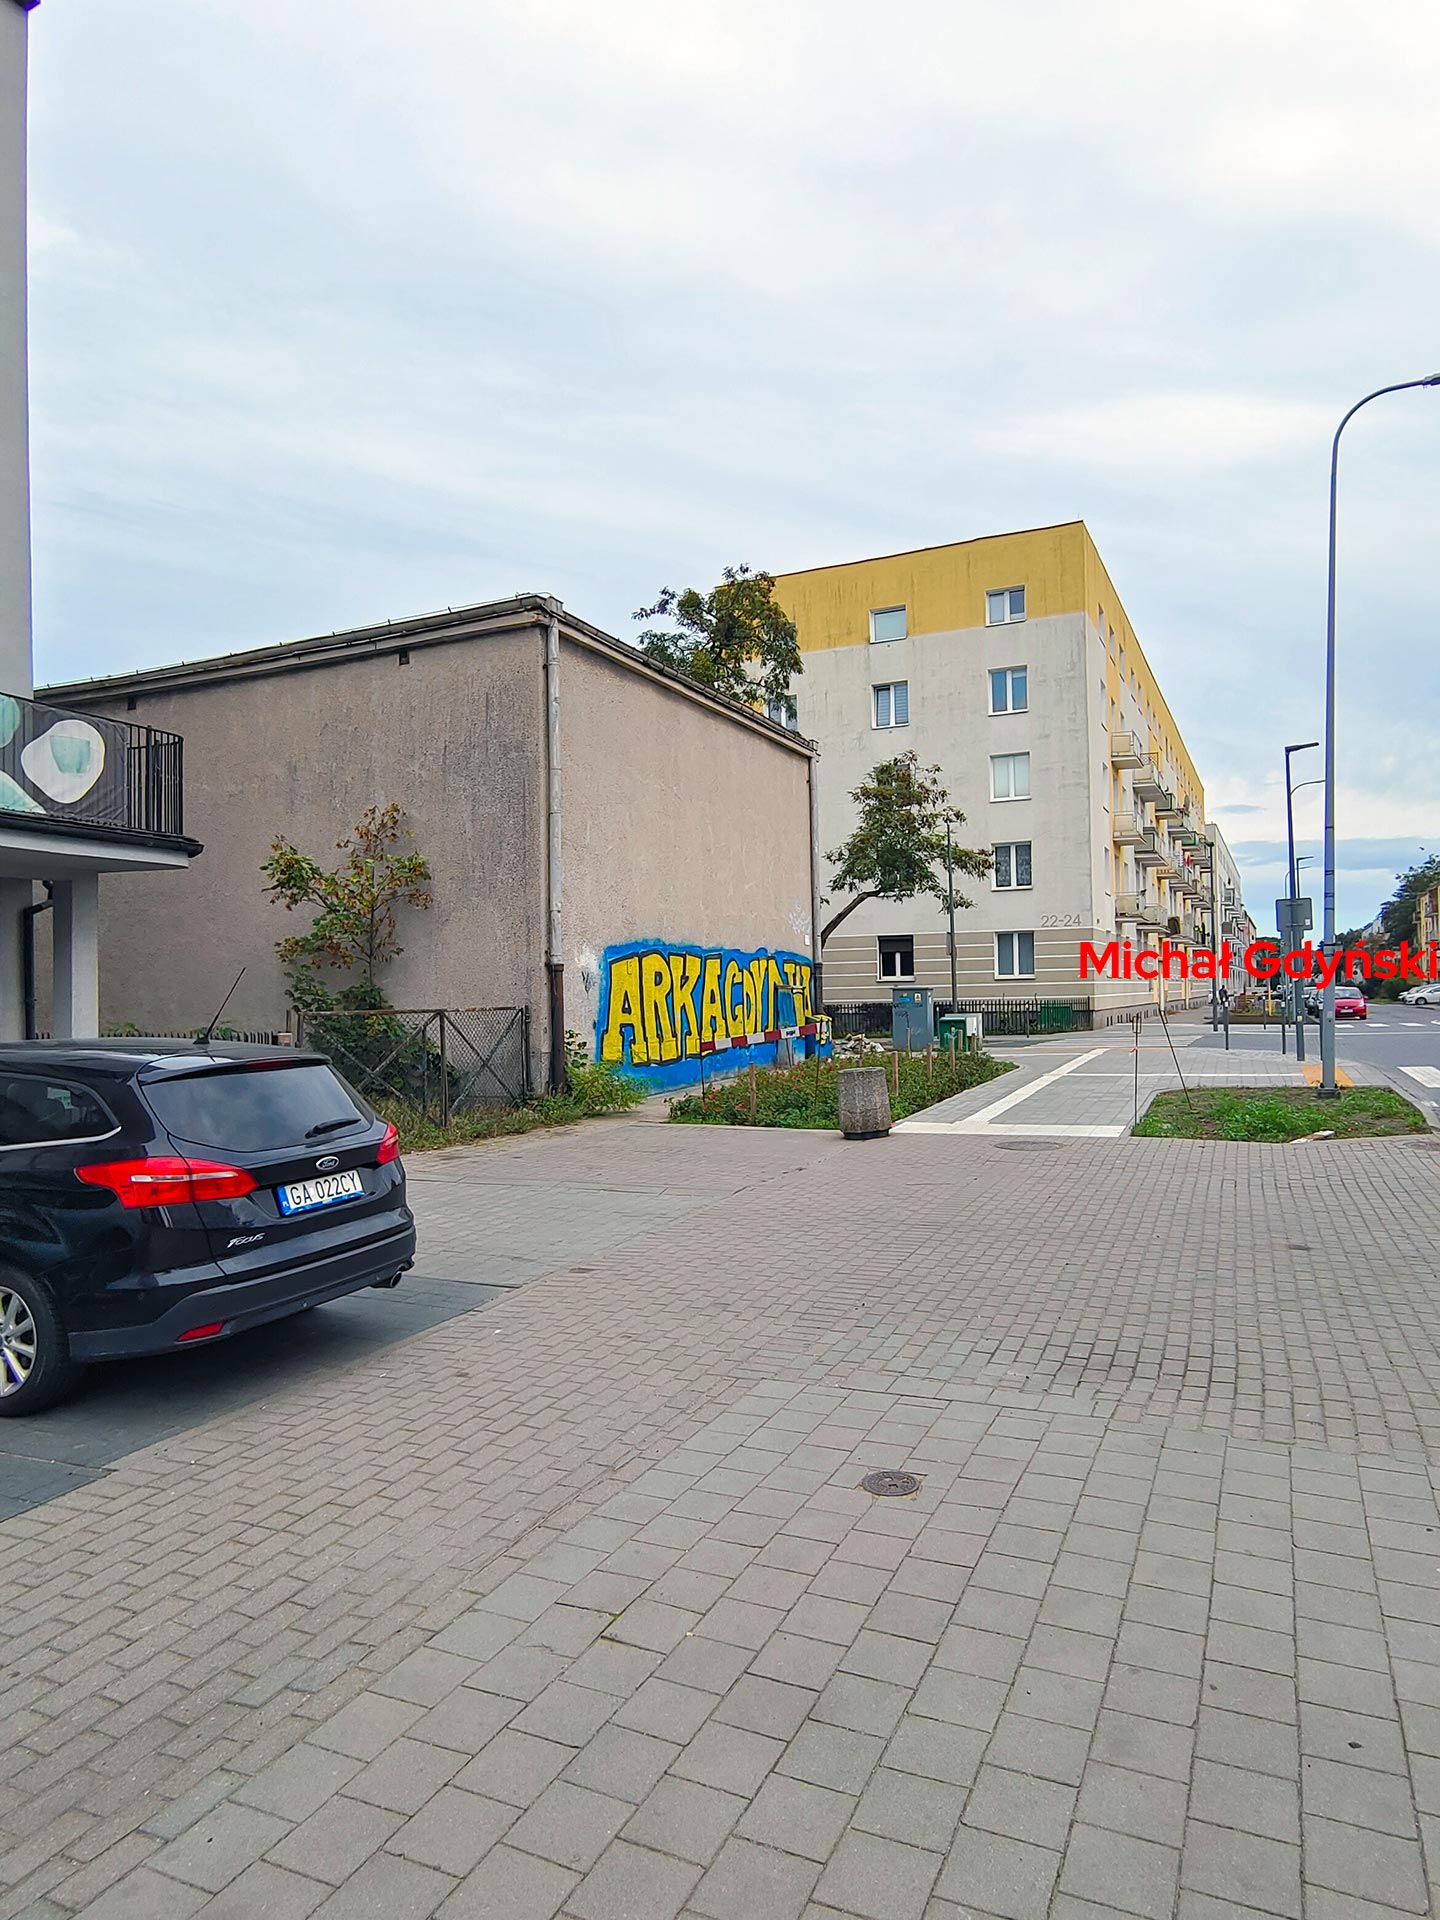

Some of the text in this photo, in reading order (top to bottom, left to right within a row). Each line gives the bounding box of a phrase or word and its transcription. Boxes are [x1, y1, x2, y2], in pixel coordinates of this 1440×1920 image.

[1040, 914, 1082, 928] 22-24
[290, 1184, 313, 1206] GA
[315, 1172, 358, 1199] 022CY
[227, 1232, 266, 1248] Focus
